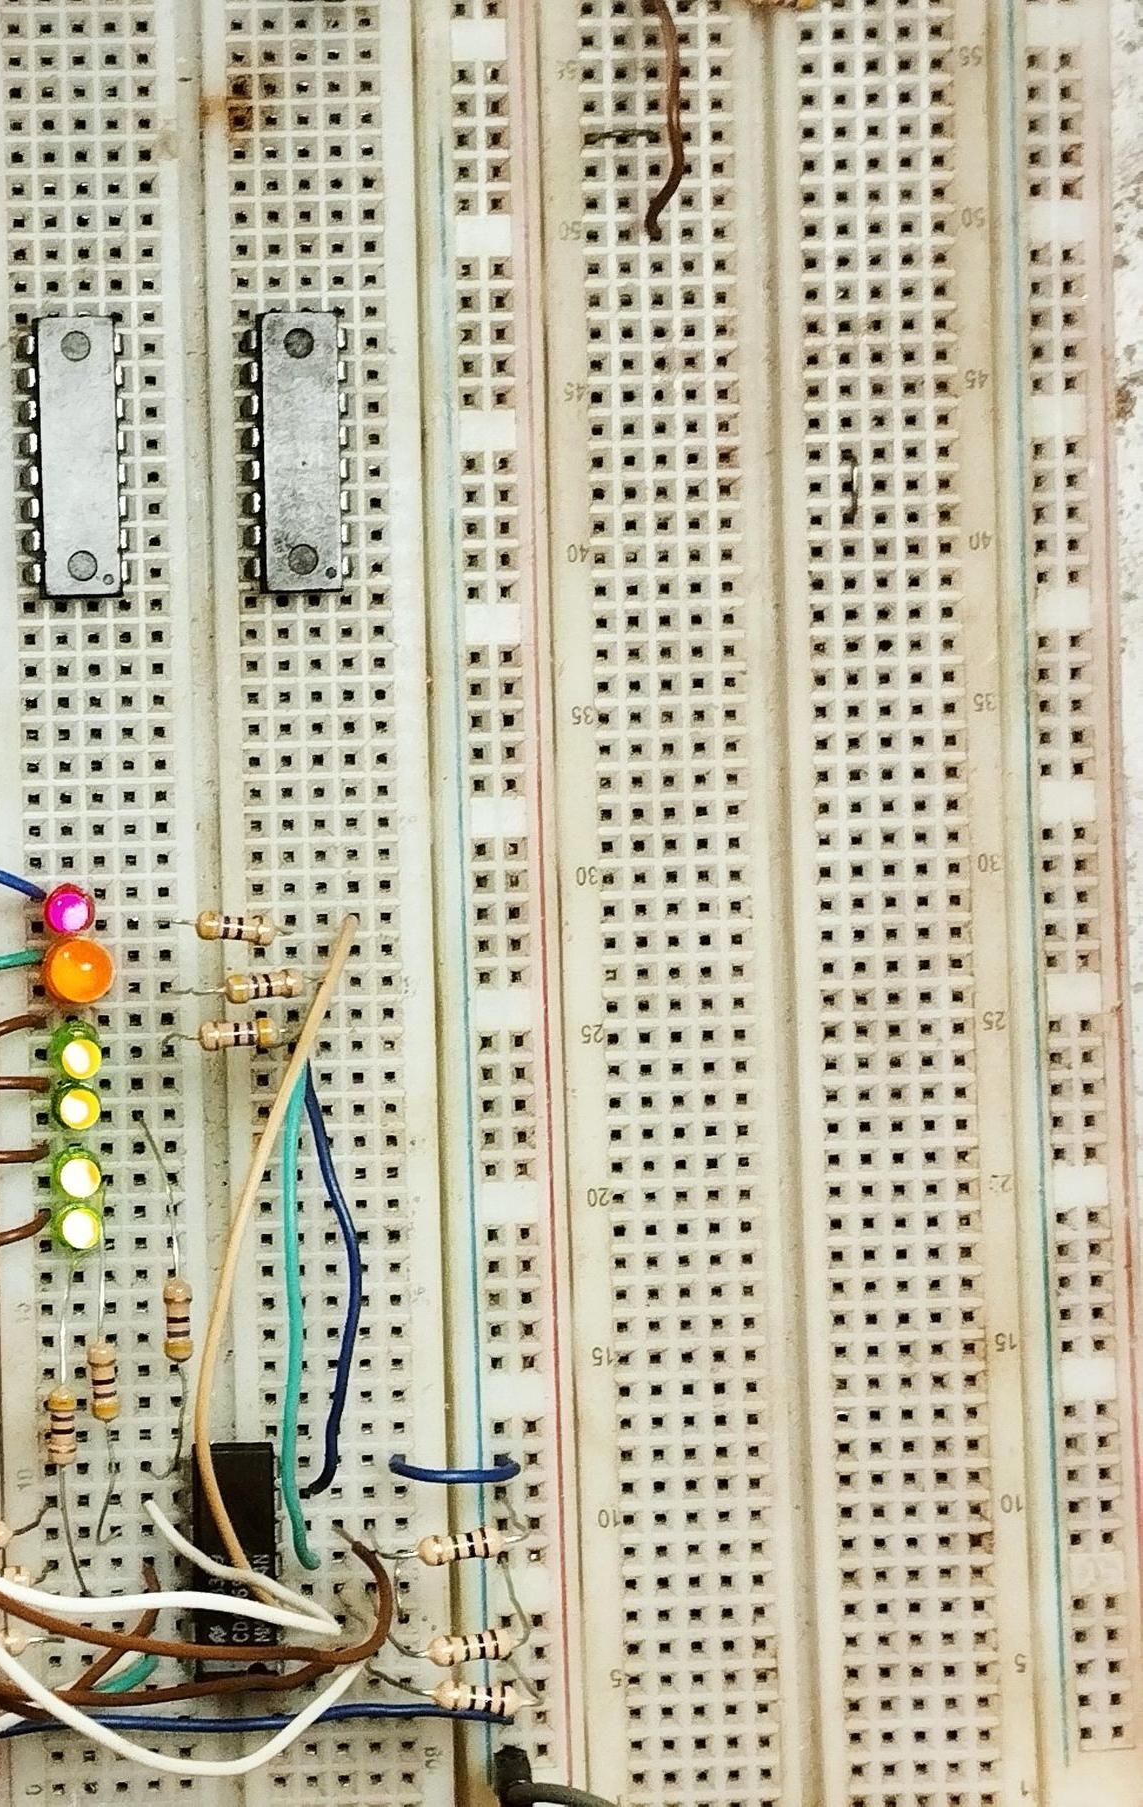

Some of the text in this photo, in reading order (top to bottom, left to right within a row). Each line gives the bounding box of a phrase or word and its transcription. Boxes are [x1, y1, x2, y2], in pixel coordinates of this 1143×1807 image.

[961, 207, 986, 228] 50
[965, 369, 989, 390] 45
[563, 382, 587, 403] 45
[566, 543, 590, 563] 40
[973, 692, 996, 713] 35
[571, 705, 594, 725] 35
[977, 853, 1002, 873] 30
[576, 866, 598, 886] 30
[983, 1011, 1006, 1031] 25
[580, 1023, 604, 1044] 25
[586, 1188, 610, 1208] 20
[995, 1333, 1017, 1353] 15
[592, 1346, 614, 1367] 15
[1000, 1494, 1024, 1514] 10
[598, 1508, 621, 1528] 10
[1014, 1653, 1027, 1673] 5
[610, 1668, 623, 1688] 5
